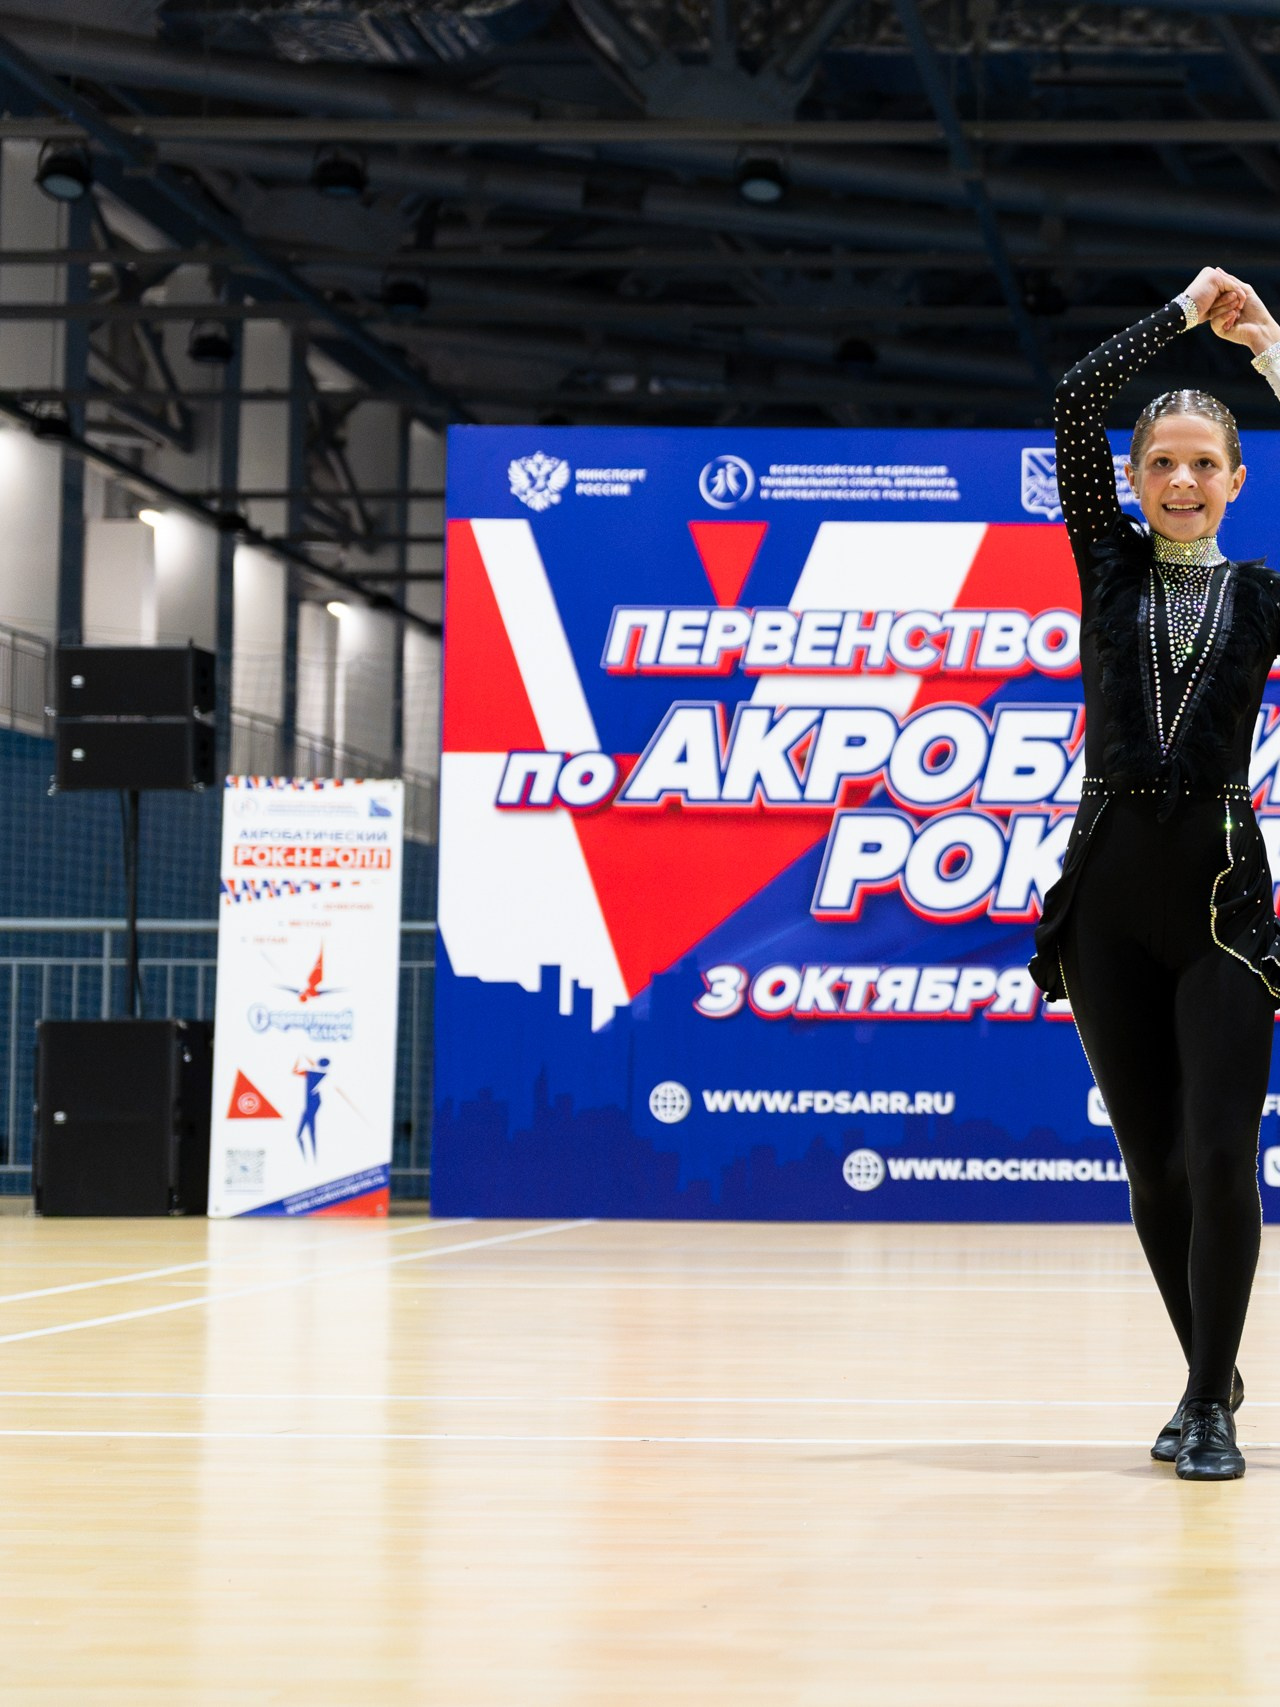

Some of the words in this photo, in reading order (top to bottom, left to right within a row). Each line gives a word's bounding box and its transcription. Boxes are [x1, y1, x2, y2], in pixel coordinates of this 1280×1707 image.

[575, 468, 647, 483] МИНСПОРТ
[575, 482, 631, 496] РОССИИ
[601, 605, 1081, 675] ПЕРВЕНСТВО
[239, 828, 389, 842] АКРОБАТИЧЕСКИЙ
[234, 846, 390, 869] РОК-Н-РОЛЛ
[697, 963, 746, 1017] 3
[751, 965, 1036, 1019] ОКТЯБРЯ
[702, 1090, 956, 1115] WWW.FDSARR.RU
